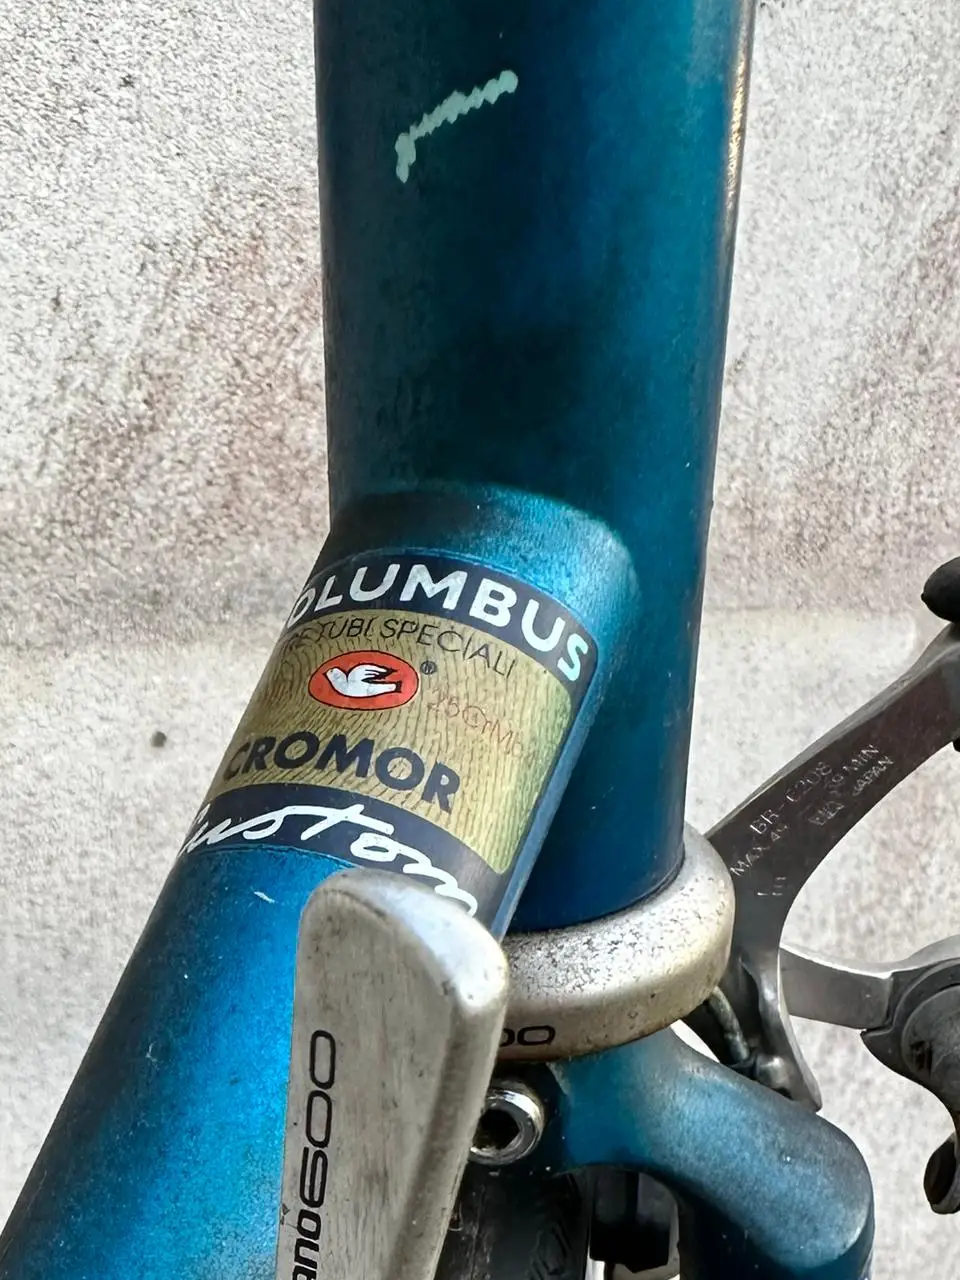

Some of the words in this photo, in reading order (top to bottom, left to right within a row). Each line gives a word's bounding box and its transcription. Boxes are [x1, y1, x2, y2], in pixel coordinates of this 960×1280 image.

[285, 563, 588, 682] OLUMBUS
[380, 617, 516, 679] SPECIALI
[223, 731, 461, 813] CROMOR
